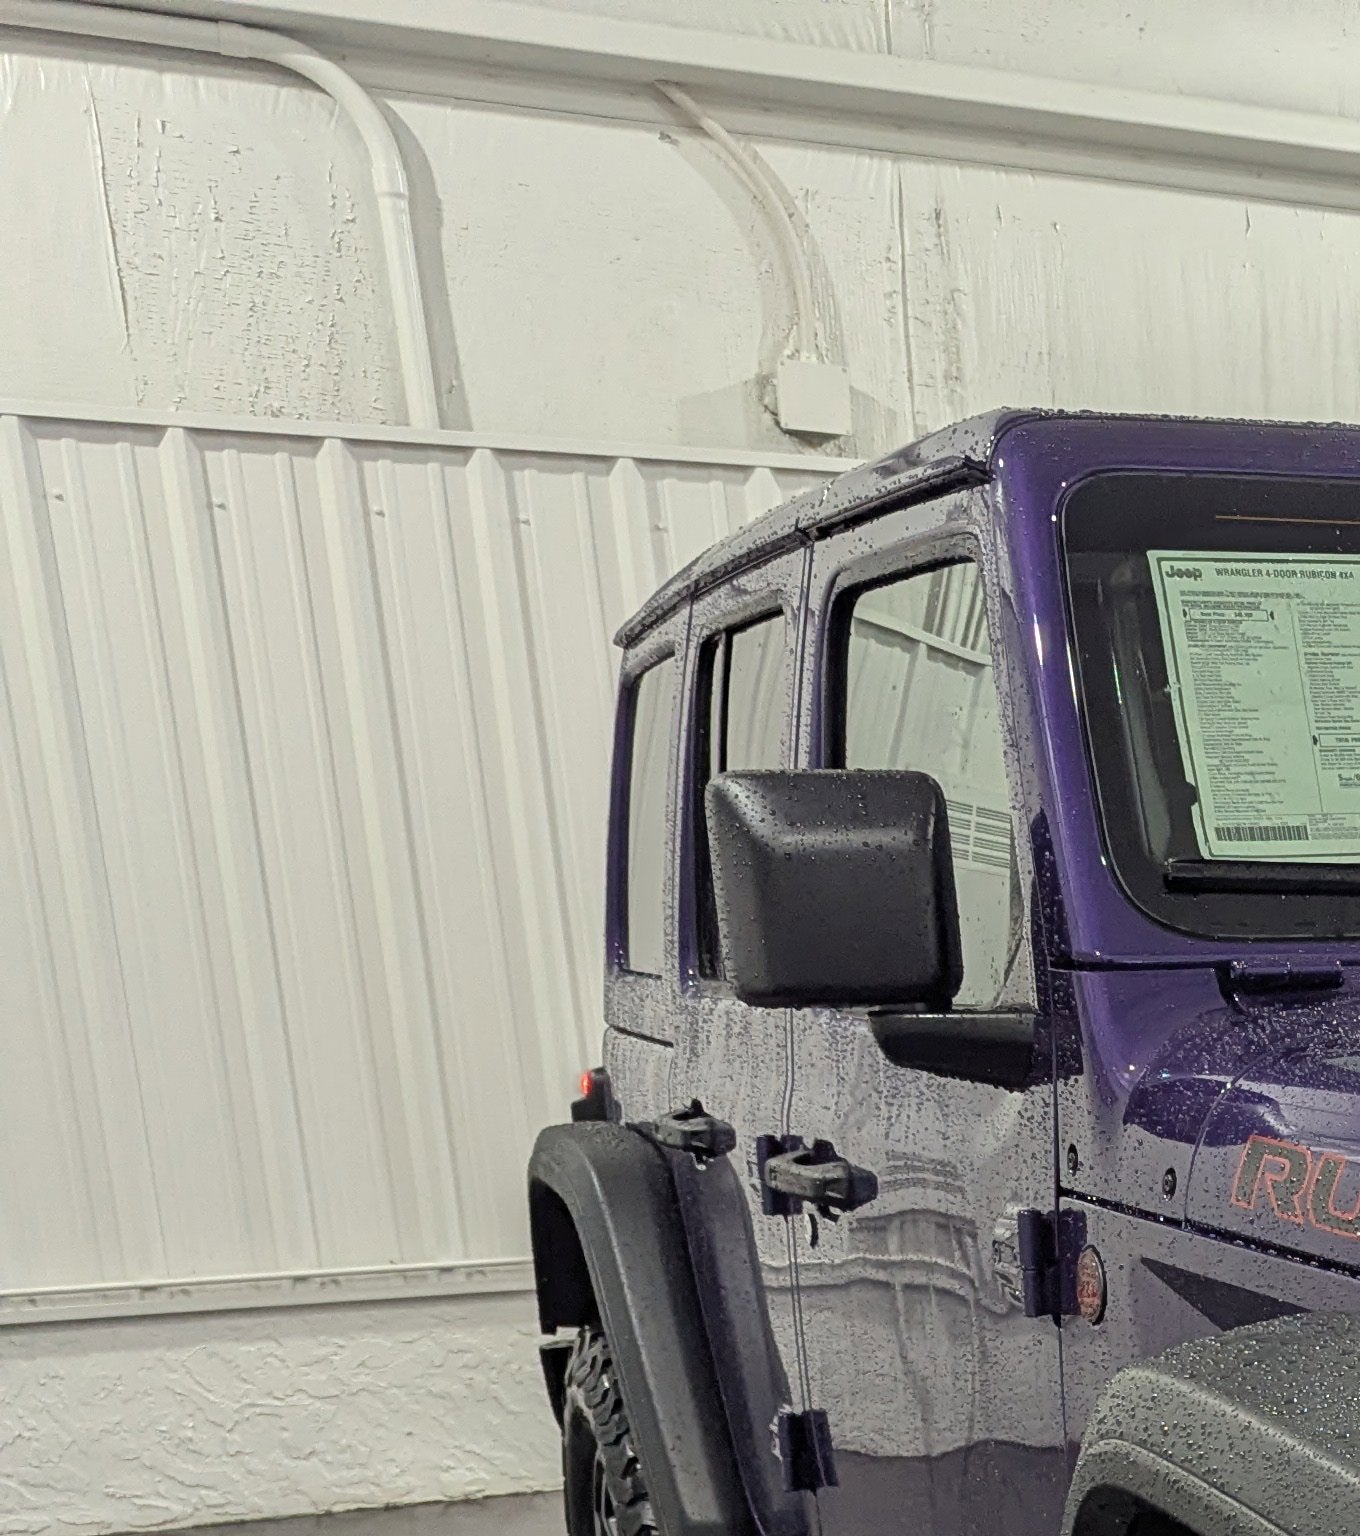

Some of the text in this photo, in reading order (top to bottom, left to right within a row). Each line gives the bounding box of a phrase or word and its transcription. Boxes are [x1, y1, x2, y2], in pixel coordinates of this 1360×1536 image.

[1165, 565, 1203, 581] Jeep
[1215, 568, 1263, 578] WRANGLER
[1265, 569, 1298, 579] 4-DOOR
[1299, 570, 1337, 580] RUBICON
